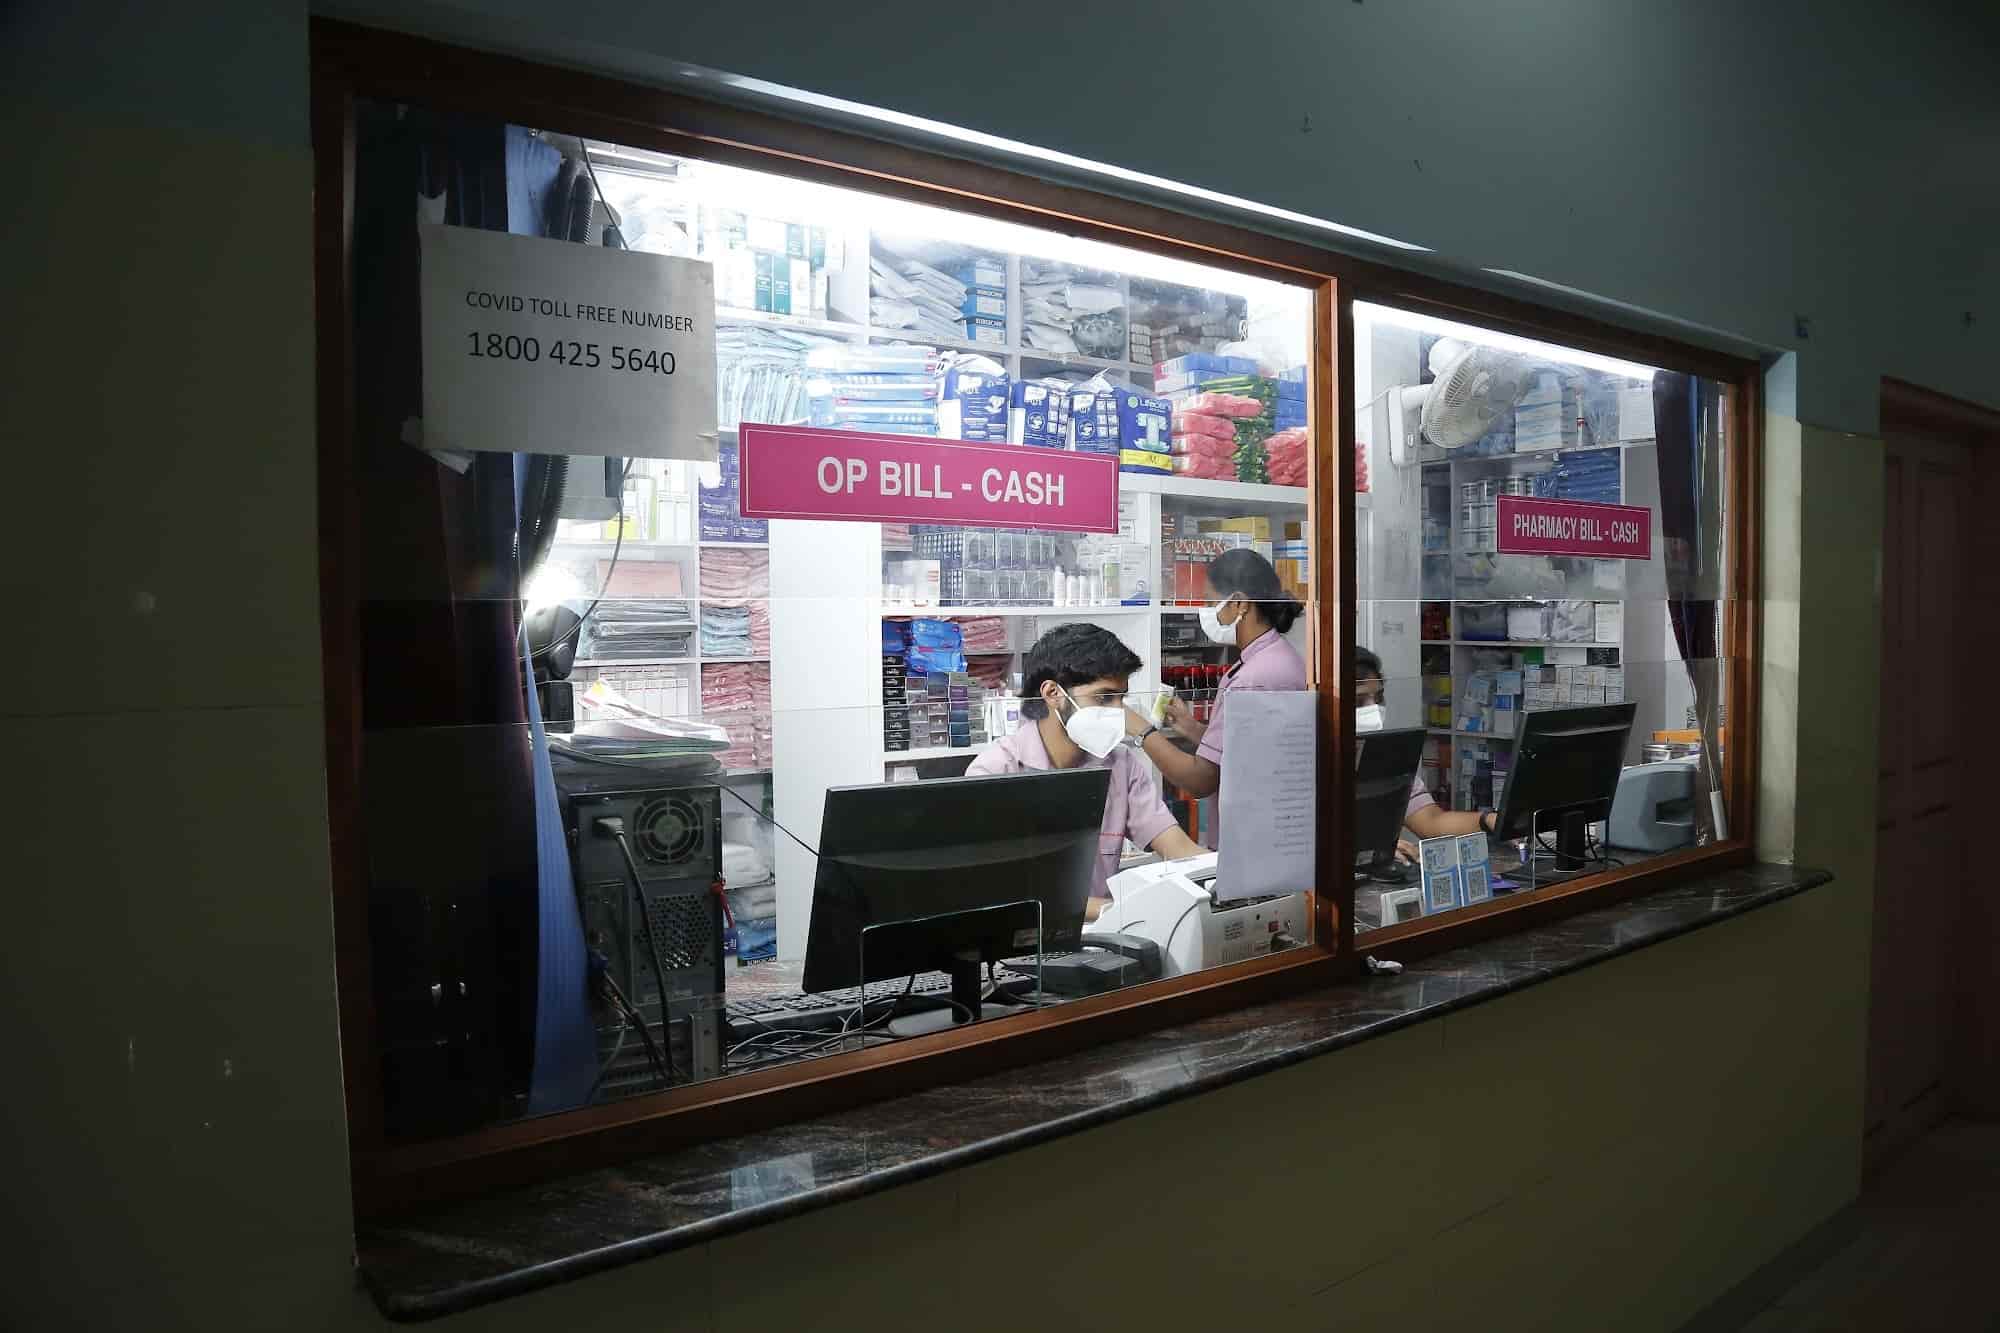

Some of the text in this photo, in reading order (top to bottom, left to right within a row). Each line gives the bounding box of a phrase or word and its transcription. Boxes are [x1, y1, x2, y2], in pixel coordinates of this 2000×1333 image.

[466, 291, 694, 332] COVID TOLL FREE NUMBER
[468, 332, 676, 375] 1800 425 5640
[817, 456, 1065, 506] OP BILL - CASH
[1514, 513, 1577, 540] PHARMACY
[1580, 518, 1603, 542] BILL
[1611, 521, 1639, 544] CASH
